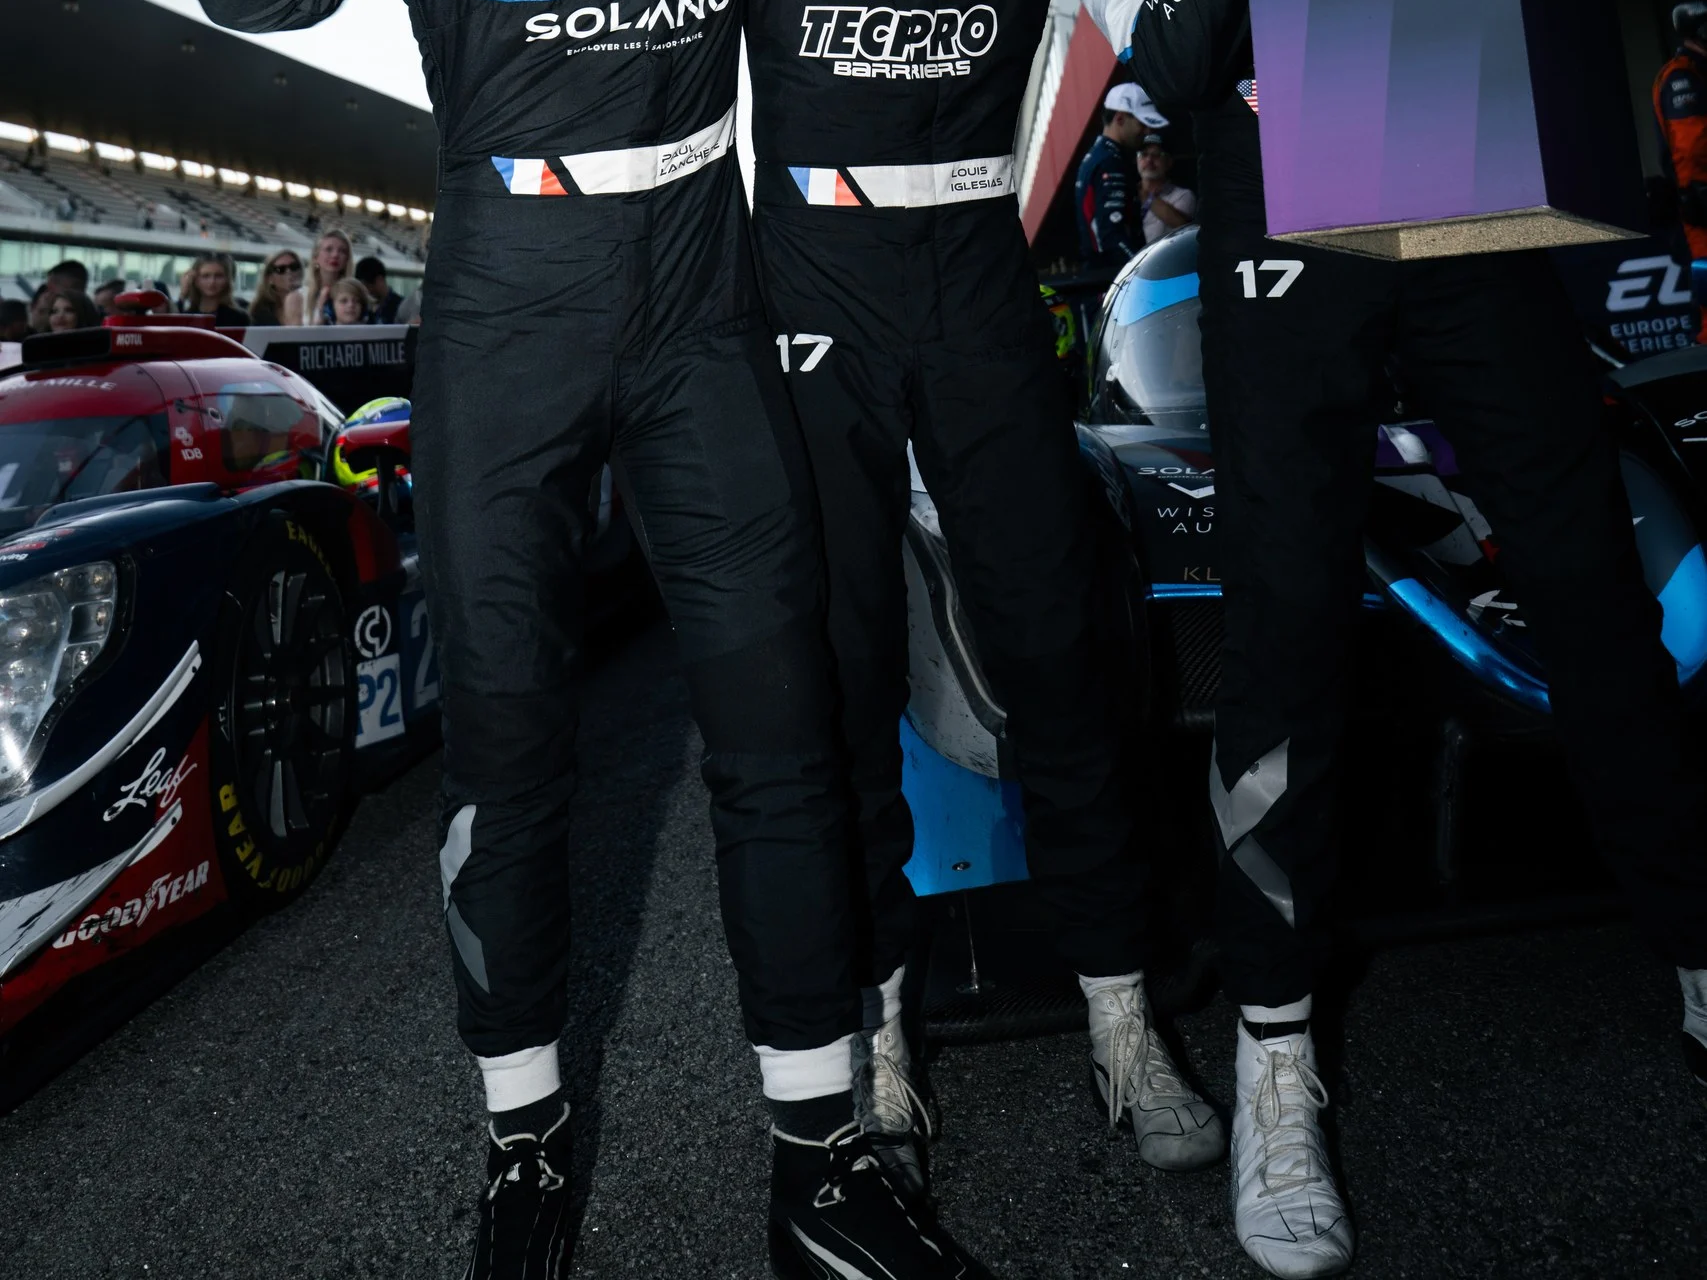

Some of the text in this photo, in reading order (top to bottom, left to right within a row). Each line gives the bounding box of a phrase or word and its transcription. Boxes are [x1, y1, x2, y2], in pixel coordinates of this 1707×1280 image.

[799, 4, 998, 62] TECPRO
[624, 41, 642, 50] LES
[951, 166, 988, 178] LOUIS
[950, 177, 1003, 192] IGLESIAS
[1234, 259, 1305, 299] 17
[115, 333, 143, 347] MOTUL
[1619, 332, 1689, 355] ERIES
[300, 341, 407, 371] RICHARD MILLE
[775, 332, 834, 373] 17
[1157, 506, 1215, 518] WIS
[1172, 522, 1213, 534] AU
[1184, 566, 1222, 581] KL
[103, 746, 199, 823] Leaf
[52, 859, 211, 950] GOODYEAR
